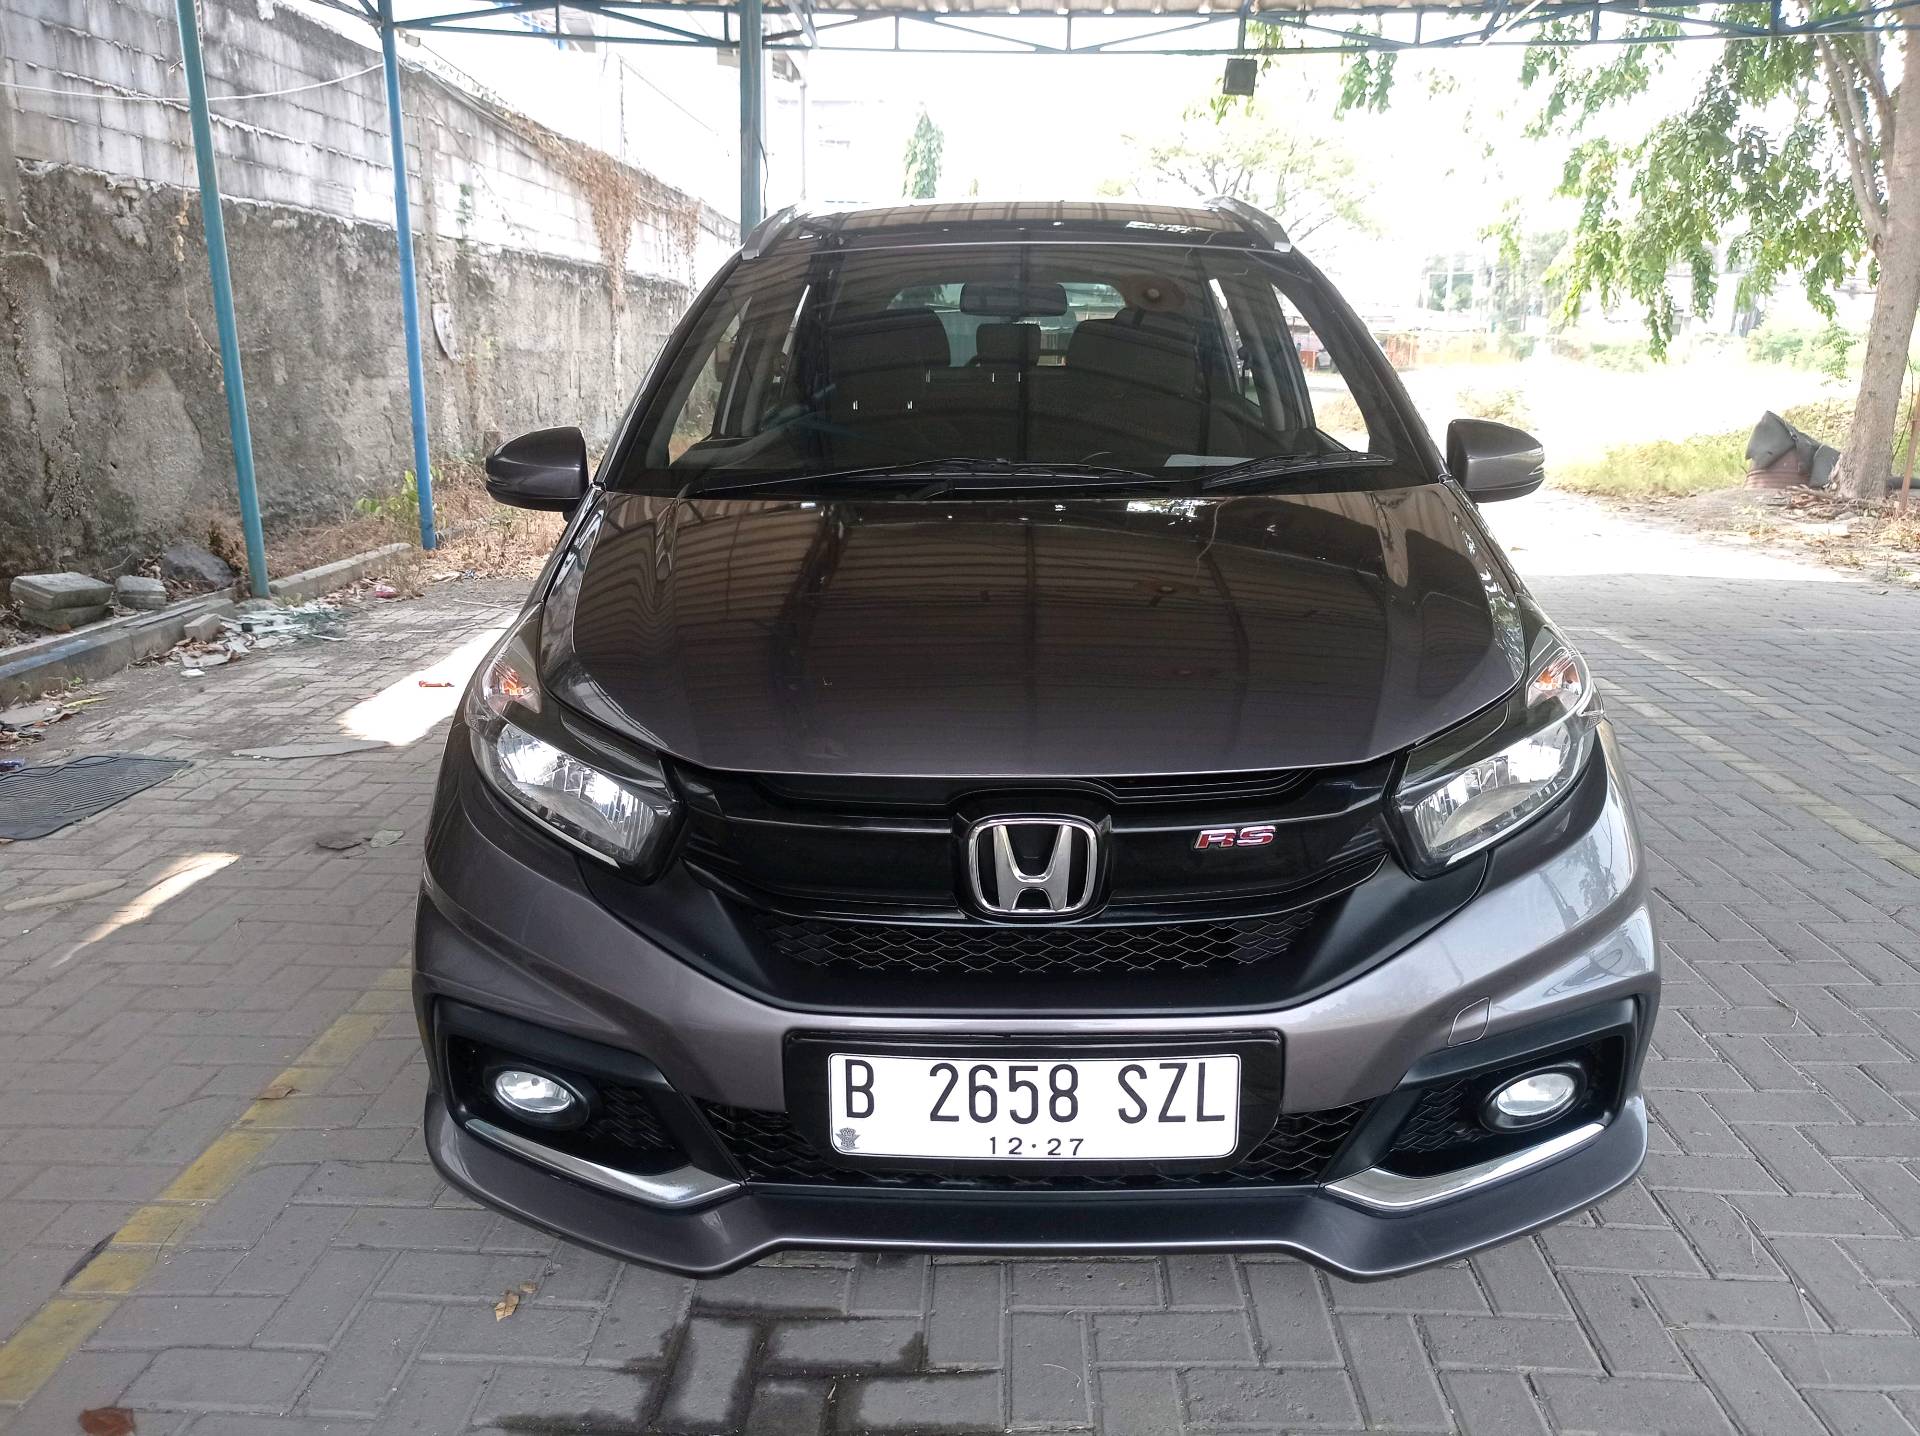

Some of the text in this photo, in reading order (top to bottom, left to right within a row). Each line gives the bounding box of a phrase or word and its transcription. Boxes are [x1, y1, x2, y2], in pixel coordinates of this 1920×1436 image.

[1194, 826, 1276, 849] RS
[845, 1059, 1225, 1124] B 2658 SZL
